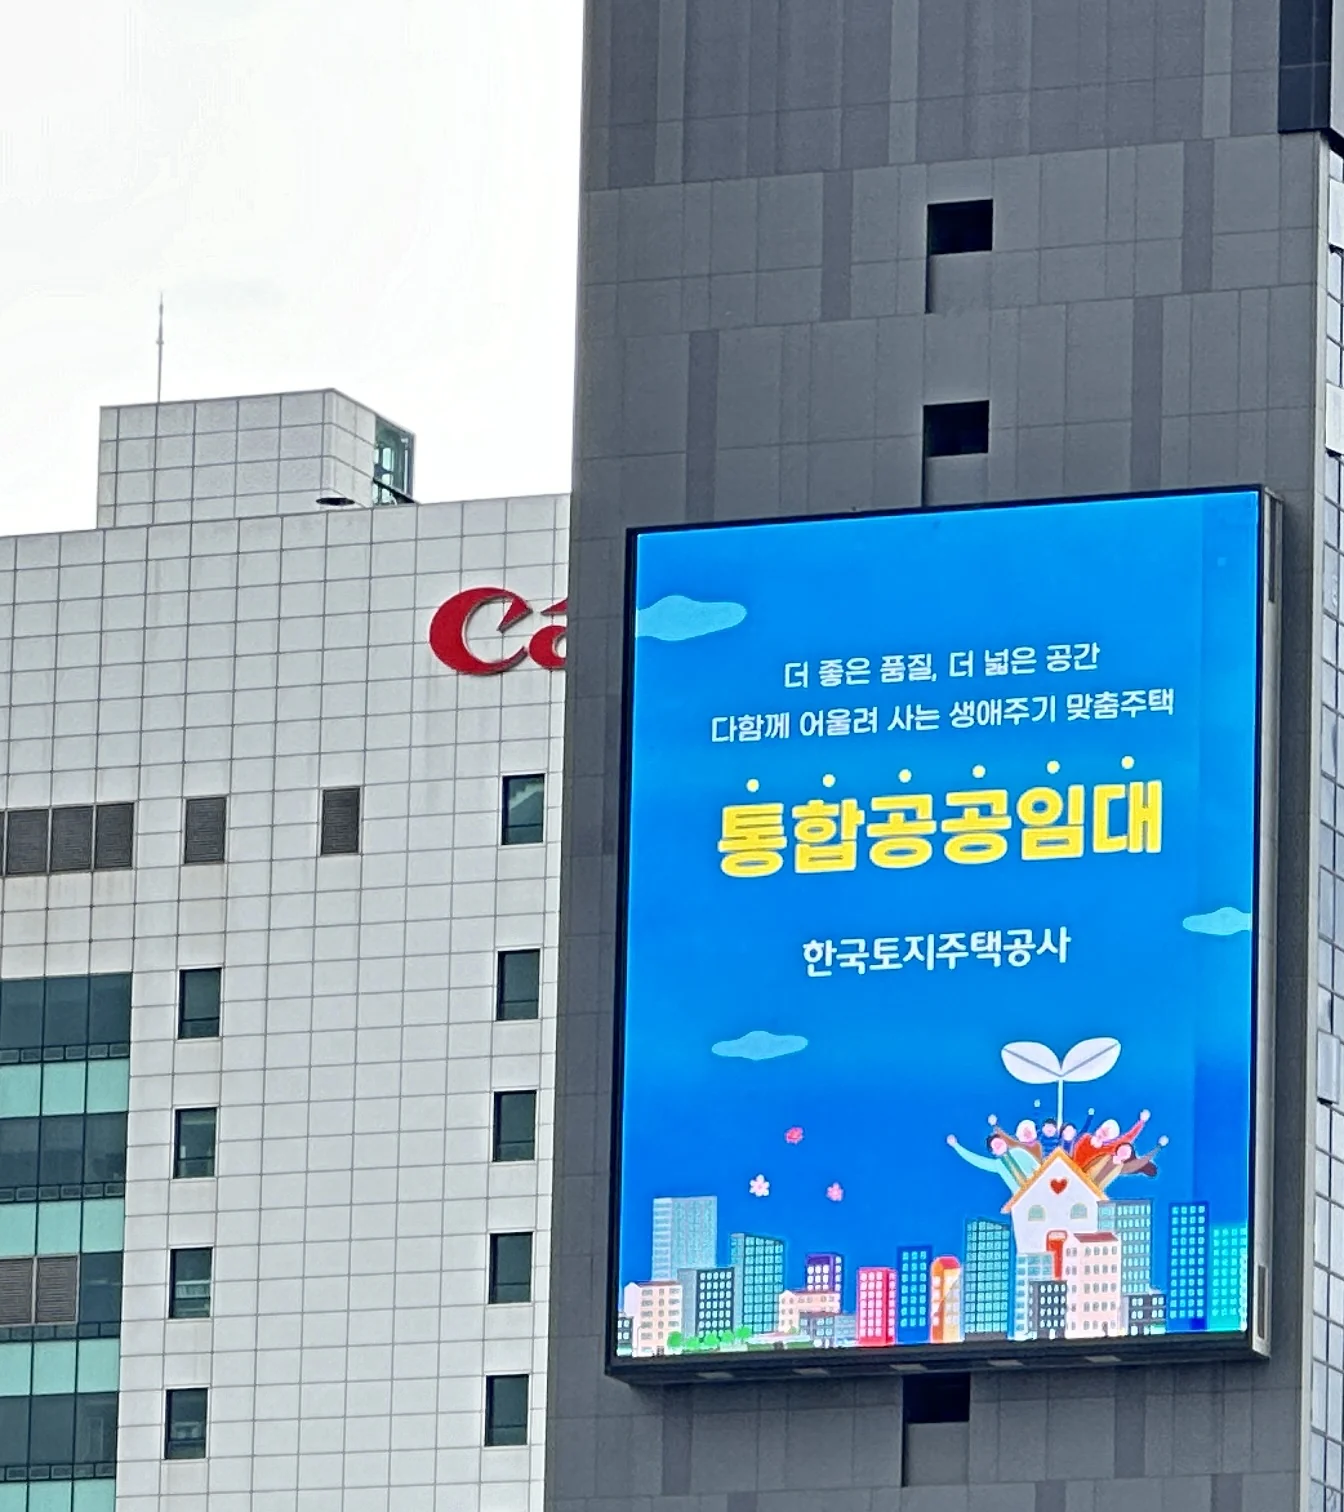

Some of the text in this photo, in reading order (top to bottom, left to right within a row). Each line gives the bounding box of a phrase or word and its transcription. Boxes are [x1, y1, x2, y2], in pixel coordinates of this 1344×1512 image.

[785, 642, 1100, 689] 더 좋은 품질, 더 넓은 공간
[711, 688, 1175, 744] 다함께 어울려 사는 생애주기 맞춤주택
[717, 778, 1163, 878] 통합공공임대
[802, 925, 1072, 978] 한국토지주택공사
